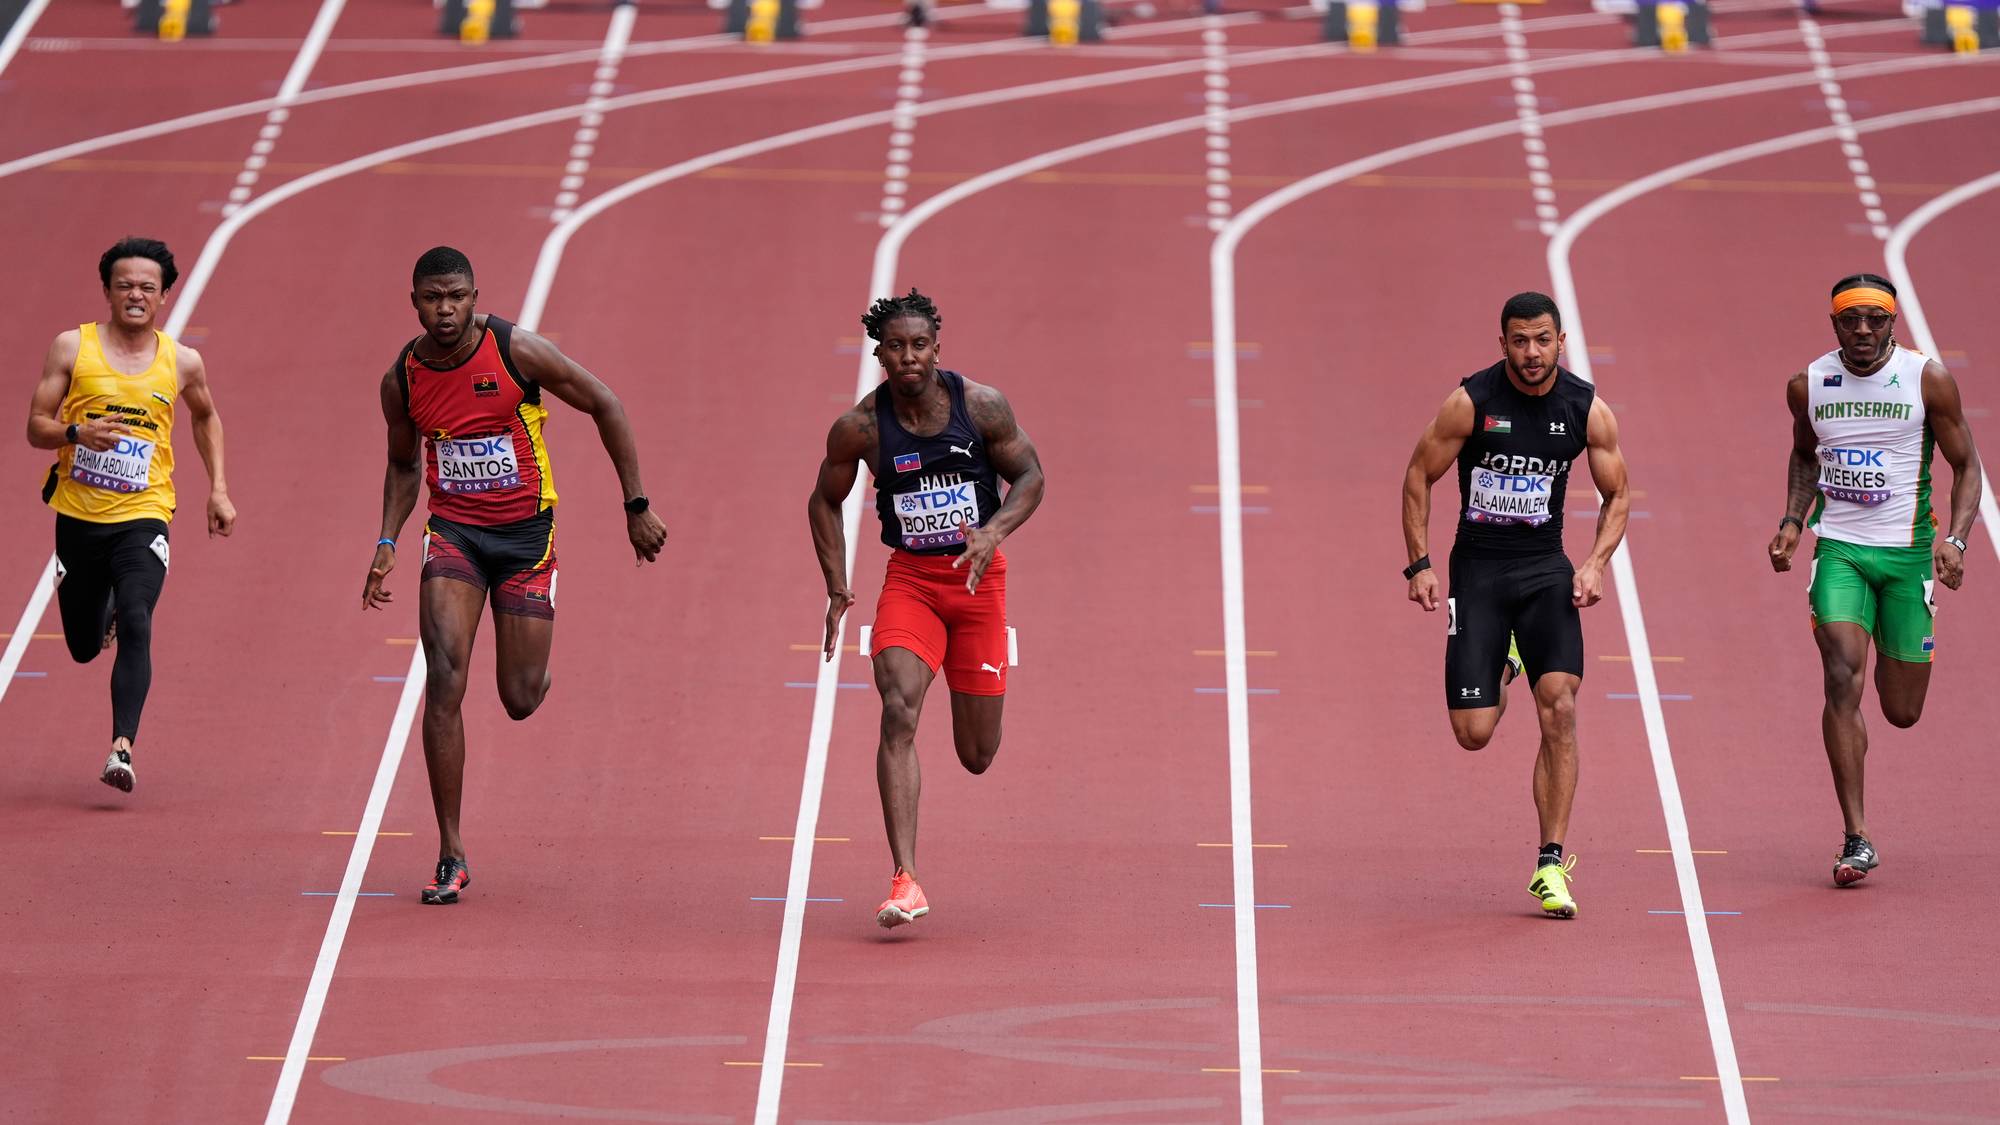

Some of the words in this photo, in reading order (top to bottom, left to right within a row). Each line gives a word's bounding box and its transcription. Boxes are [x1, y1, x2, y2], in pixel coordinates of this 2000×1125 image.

[1814, 402, 1914, 422] MONTSERRAT
[113, 438, 149, 459] DK
[453, 437, 507, 457] TDK
[1832, 448, 1884, 467] TDK
[76, 448, 102, 470] RAHIM
[102, 457, 147, 480] ABDULLAH
[442, 457, 513, 478] SANTOS
[919, 473, 962, 491] HAITI
[1494, 475, 1547, 493] TDK
[1823, 466, 1886, 488] WEEKES
[914, 485, 970, 510] TDK
[1472, 491, 1547, 515] AL-AWAMLEH
[903, 506, 975, 533] BORZOR
[920, 531, 964, 545] TOKYO
